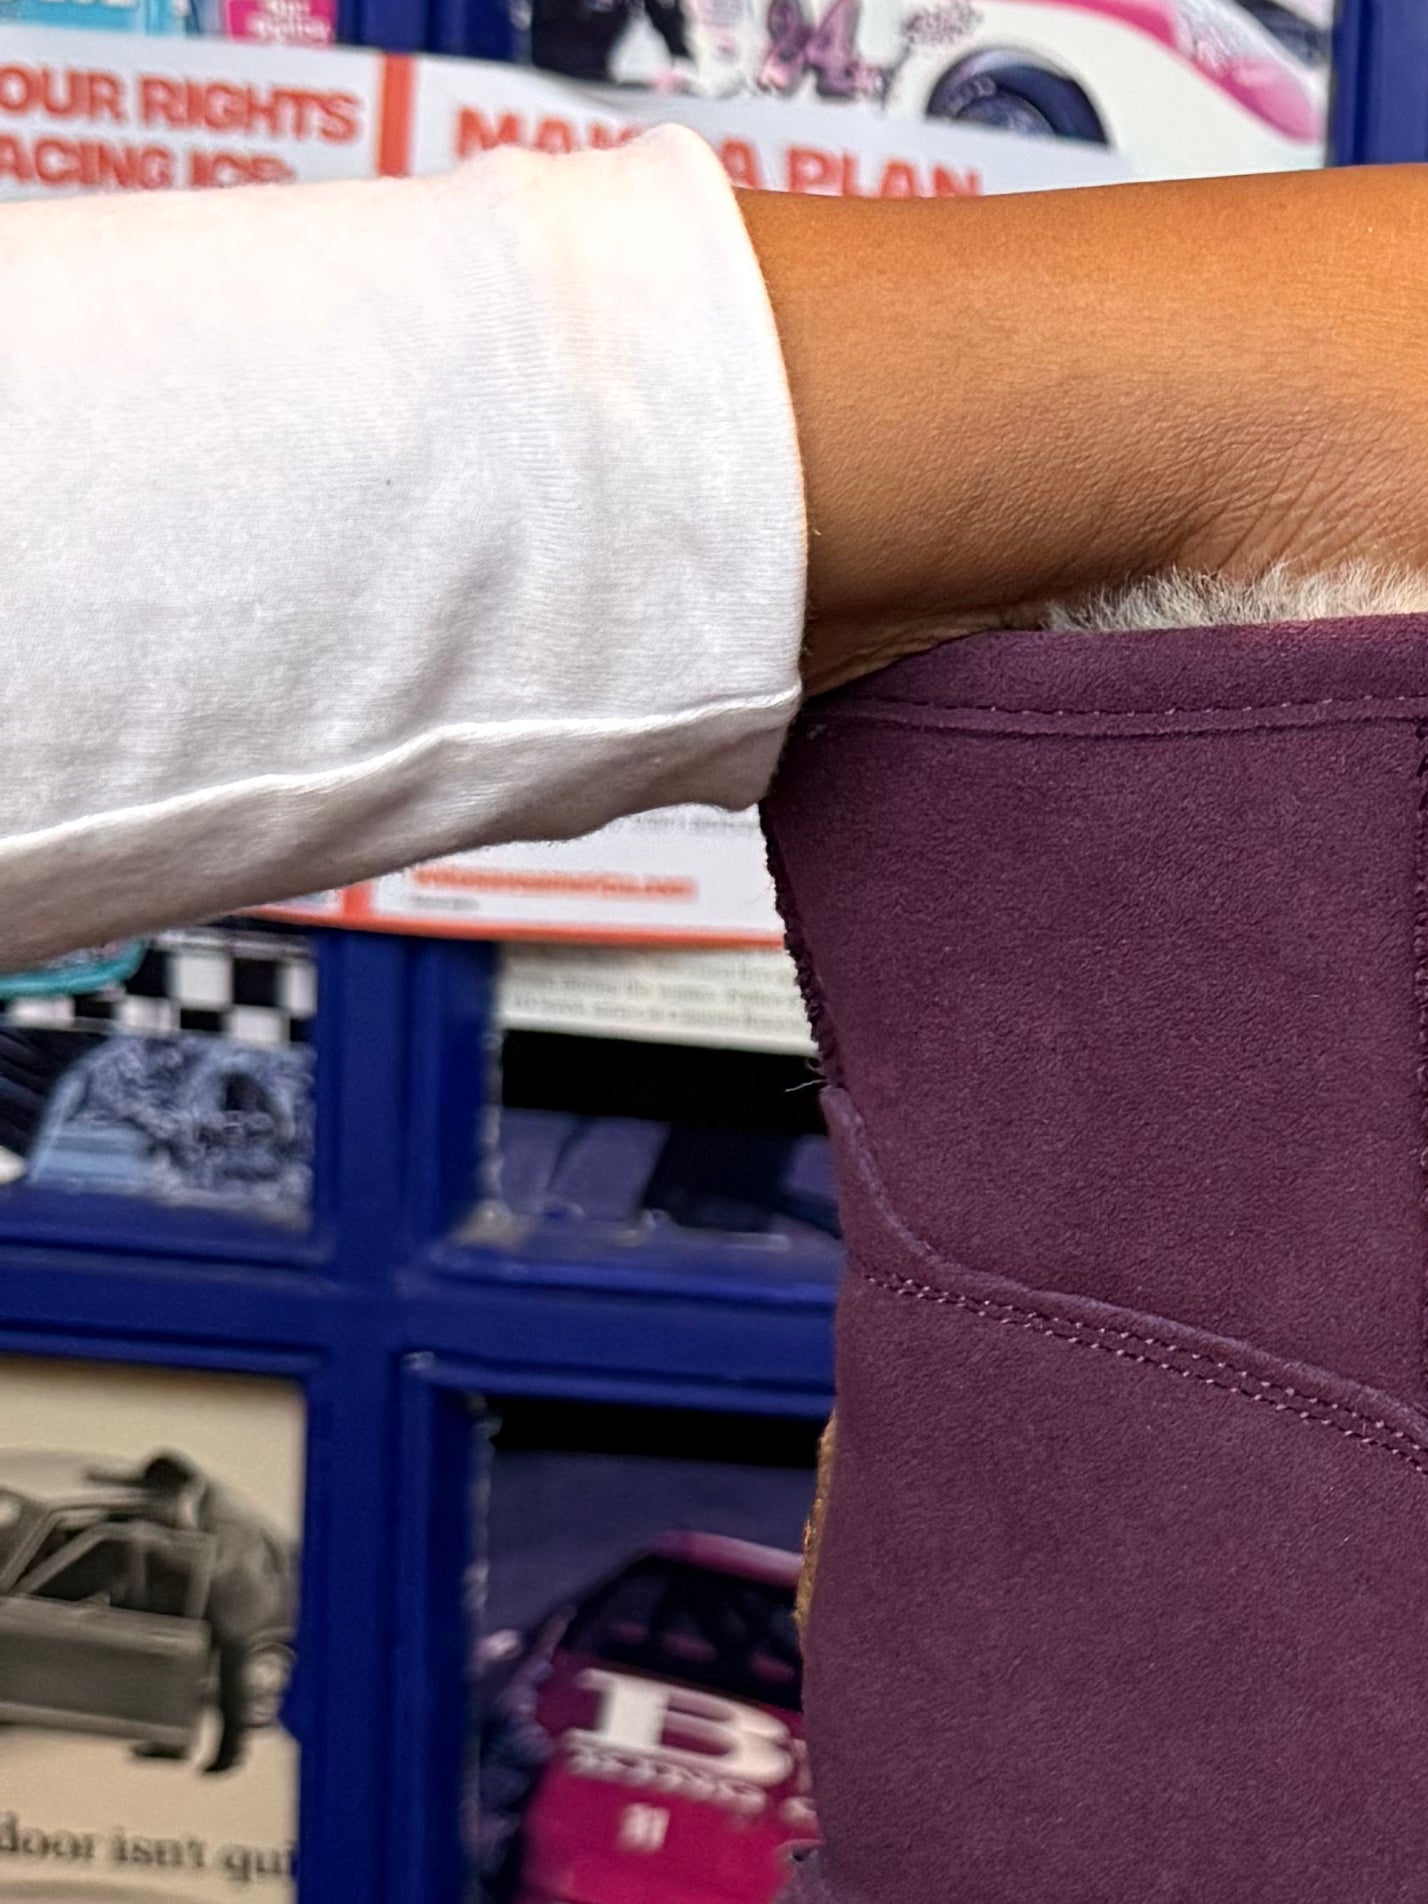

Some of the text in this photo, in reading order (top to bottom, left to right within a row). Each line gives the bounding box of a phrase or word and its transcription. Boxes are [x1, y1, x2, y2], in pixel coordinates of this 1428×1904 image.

[141, 74, 361, 144] RIGHTS
[721, 138, 763, 190] A
[786, 148, 981, 197] PLAN
[109, 1824, 207, 1869] isn't
